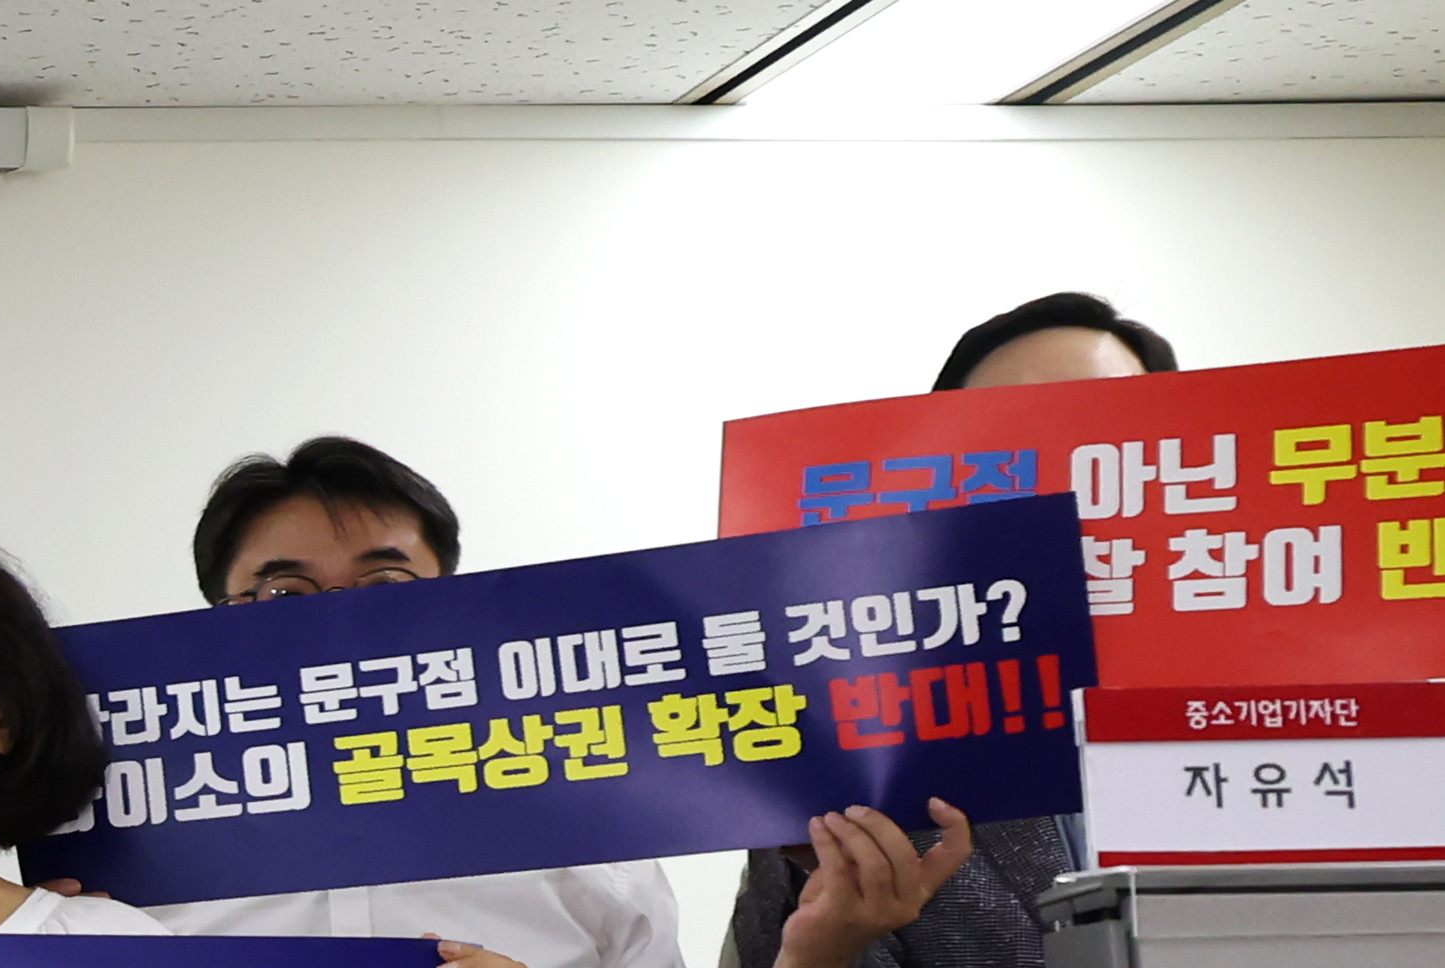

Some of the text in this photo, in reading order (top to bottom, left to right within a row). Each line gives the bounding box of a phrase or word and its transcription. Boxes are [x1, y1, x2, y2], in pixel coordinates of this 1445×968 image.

[1070, 433, 1237, 520] 아닌
[1168, 525, 1342, 612] 참여
[85, 579, 1026, 746] 라지는 문구점 이대로 둘 것인가?
[47, 656, 1062, 835] 이소의 골목상권 확장 반대!!
[1186, 699, 1358, 729] 중소기업기자단
